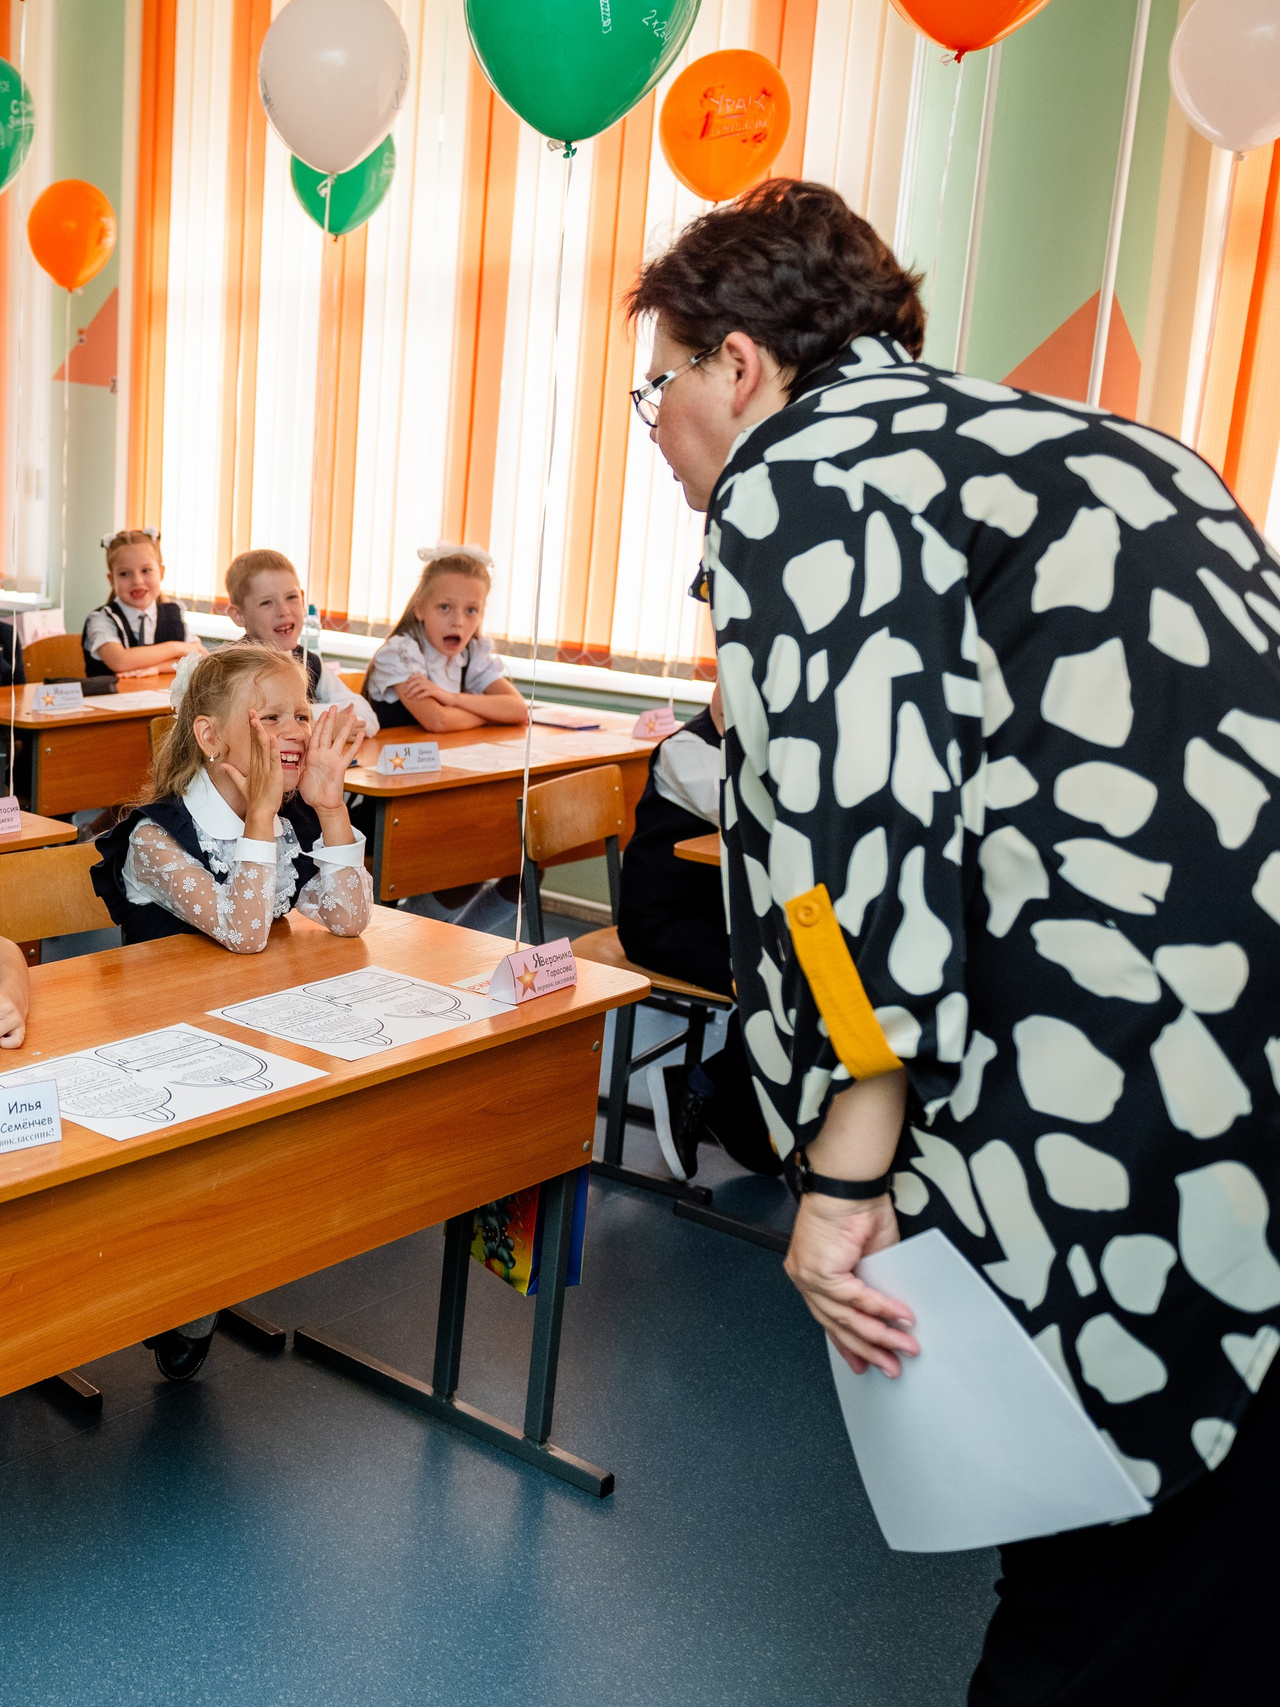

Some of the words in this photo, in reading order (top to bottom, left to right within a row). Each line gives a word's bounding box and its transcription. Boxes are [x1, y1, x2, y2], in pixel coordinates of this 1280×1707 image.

[545, 964, 573, 979] Тарасова
[7, 1100, 42, 1115] Илья
[0, 1116, 53, 1134] Семёнчев
